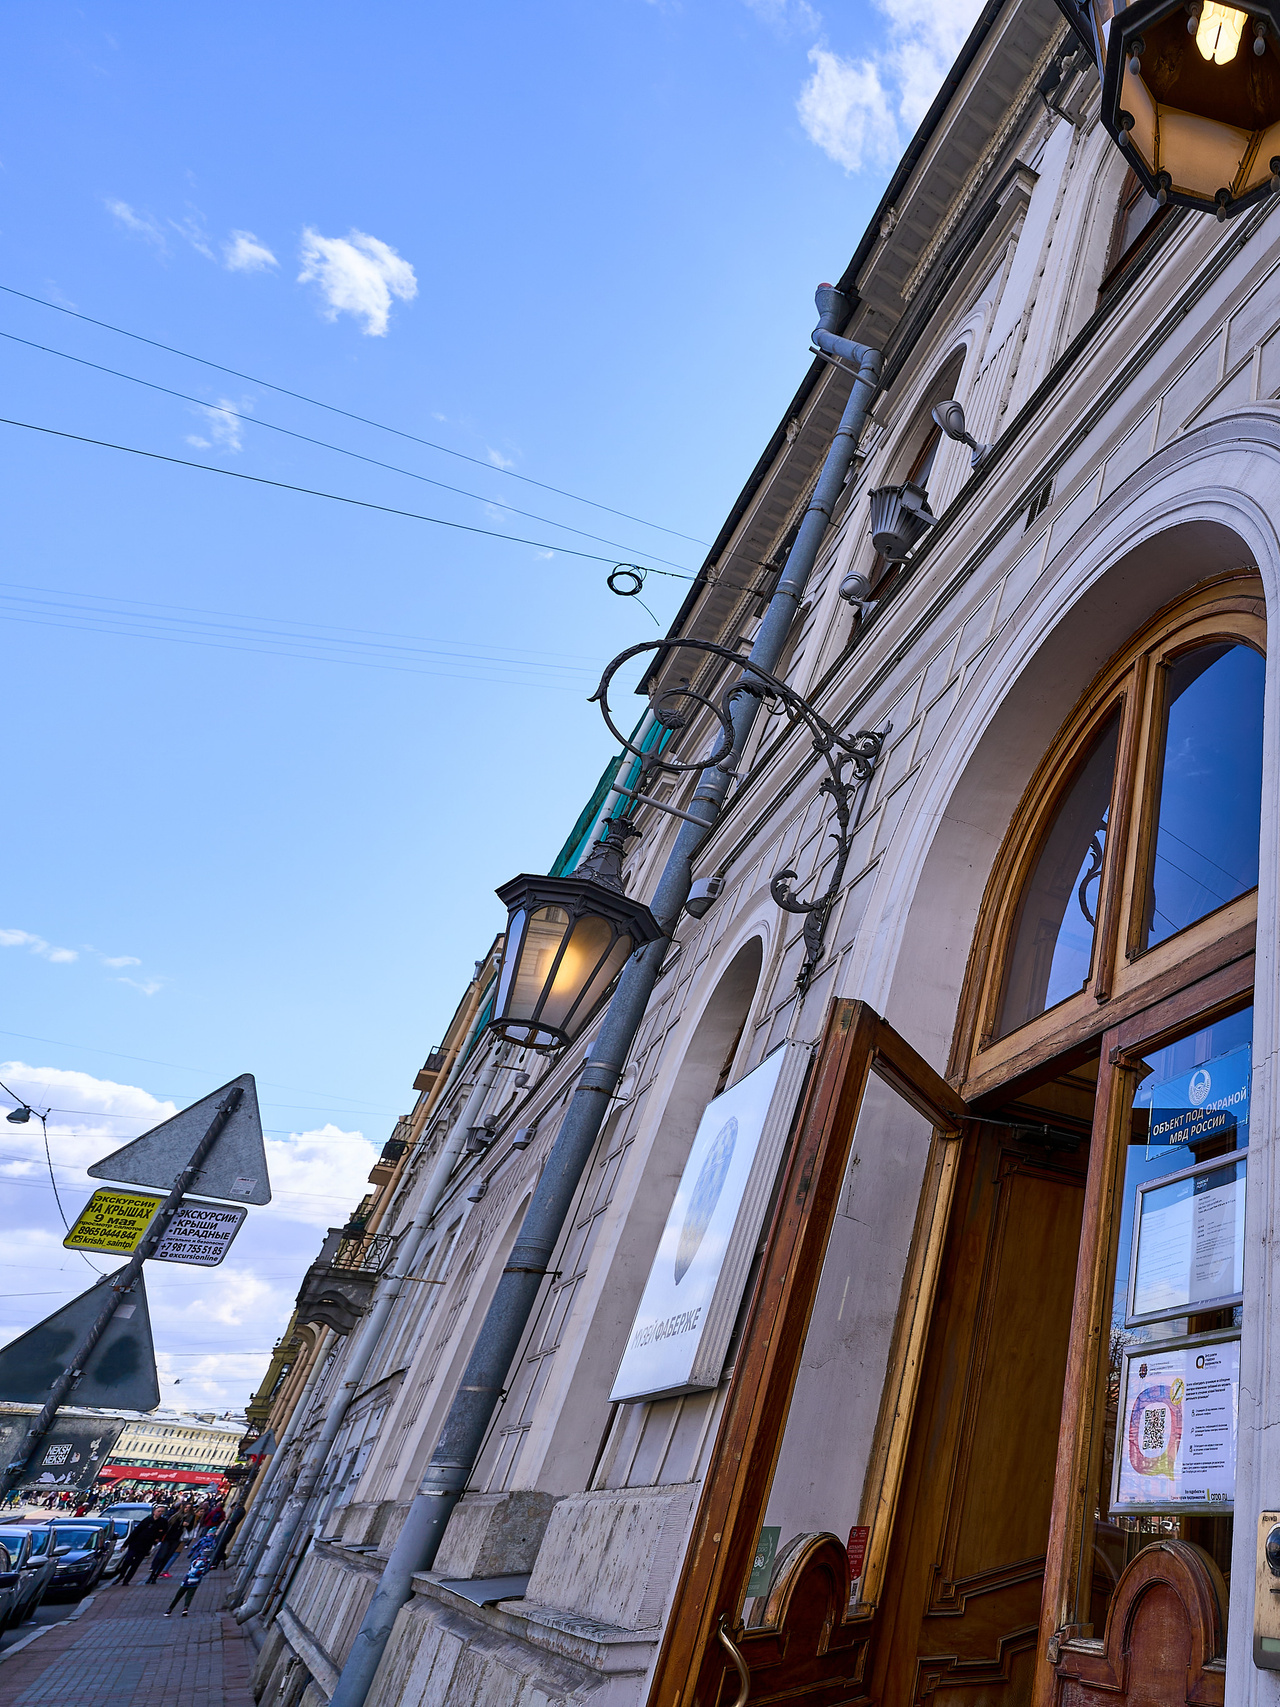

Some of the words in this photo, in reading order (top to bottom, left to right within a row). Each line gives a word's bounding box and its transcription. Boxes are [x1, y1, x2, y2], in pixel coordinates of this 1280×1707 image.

[1152, 1114, 1184, 1136] ОБЪЕКТ
[1185, 1107, 1204, 1123] ПОД
[1205, 1086, 1247, 1115] ОХРАНОЙ
[1169, 1127, 1189, 1145] МВД
[1190, 1113, 1226, 1137] РОССИИ
[95, 1195, 156, 1208] ЭКСКУРСИИ
[87, 1202, 102, 1213] НА
[104, 1204, 153, 1219] КРЫШАХ
[178, 1209, 238, 1223] ЭКСКУРСИИ:
[93, 1214, 104, 1223] 9
[107, 1217, 137, 1227] мая
[168, 1253, 219, 1262] excursionline
